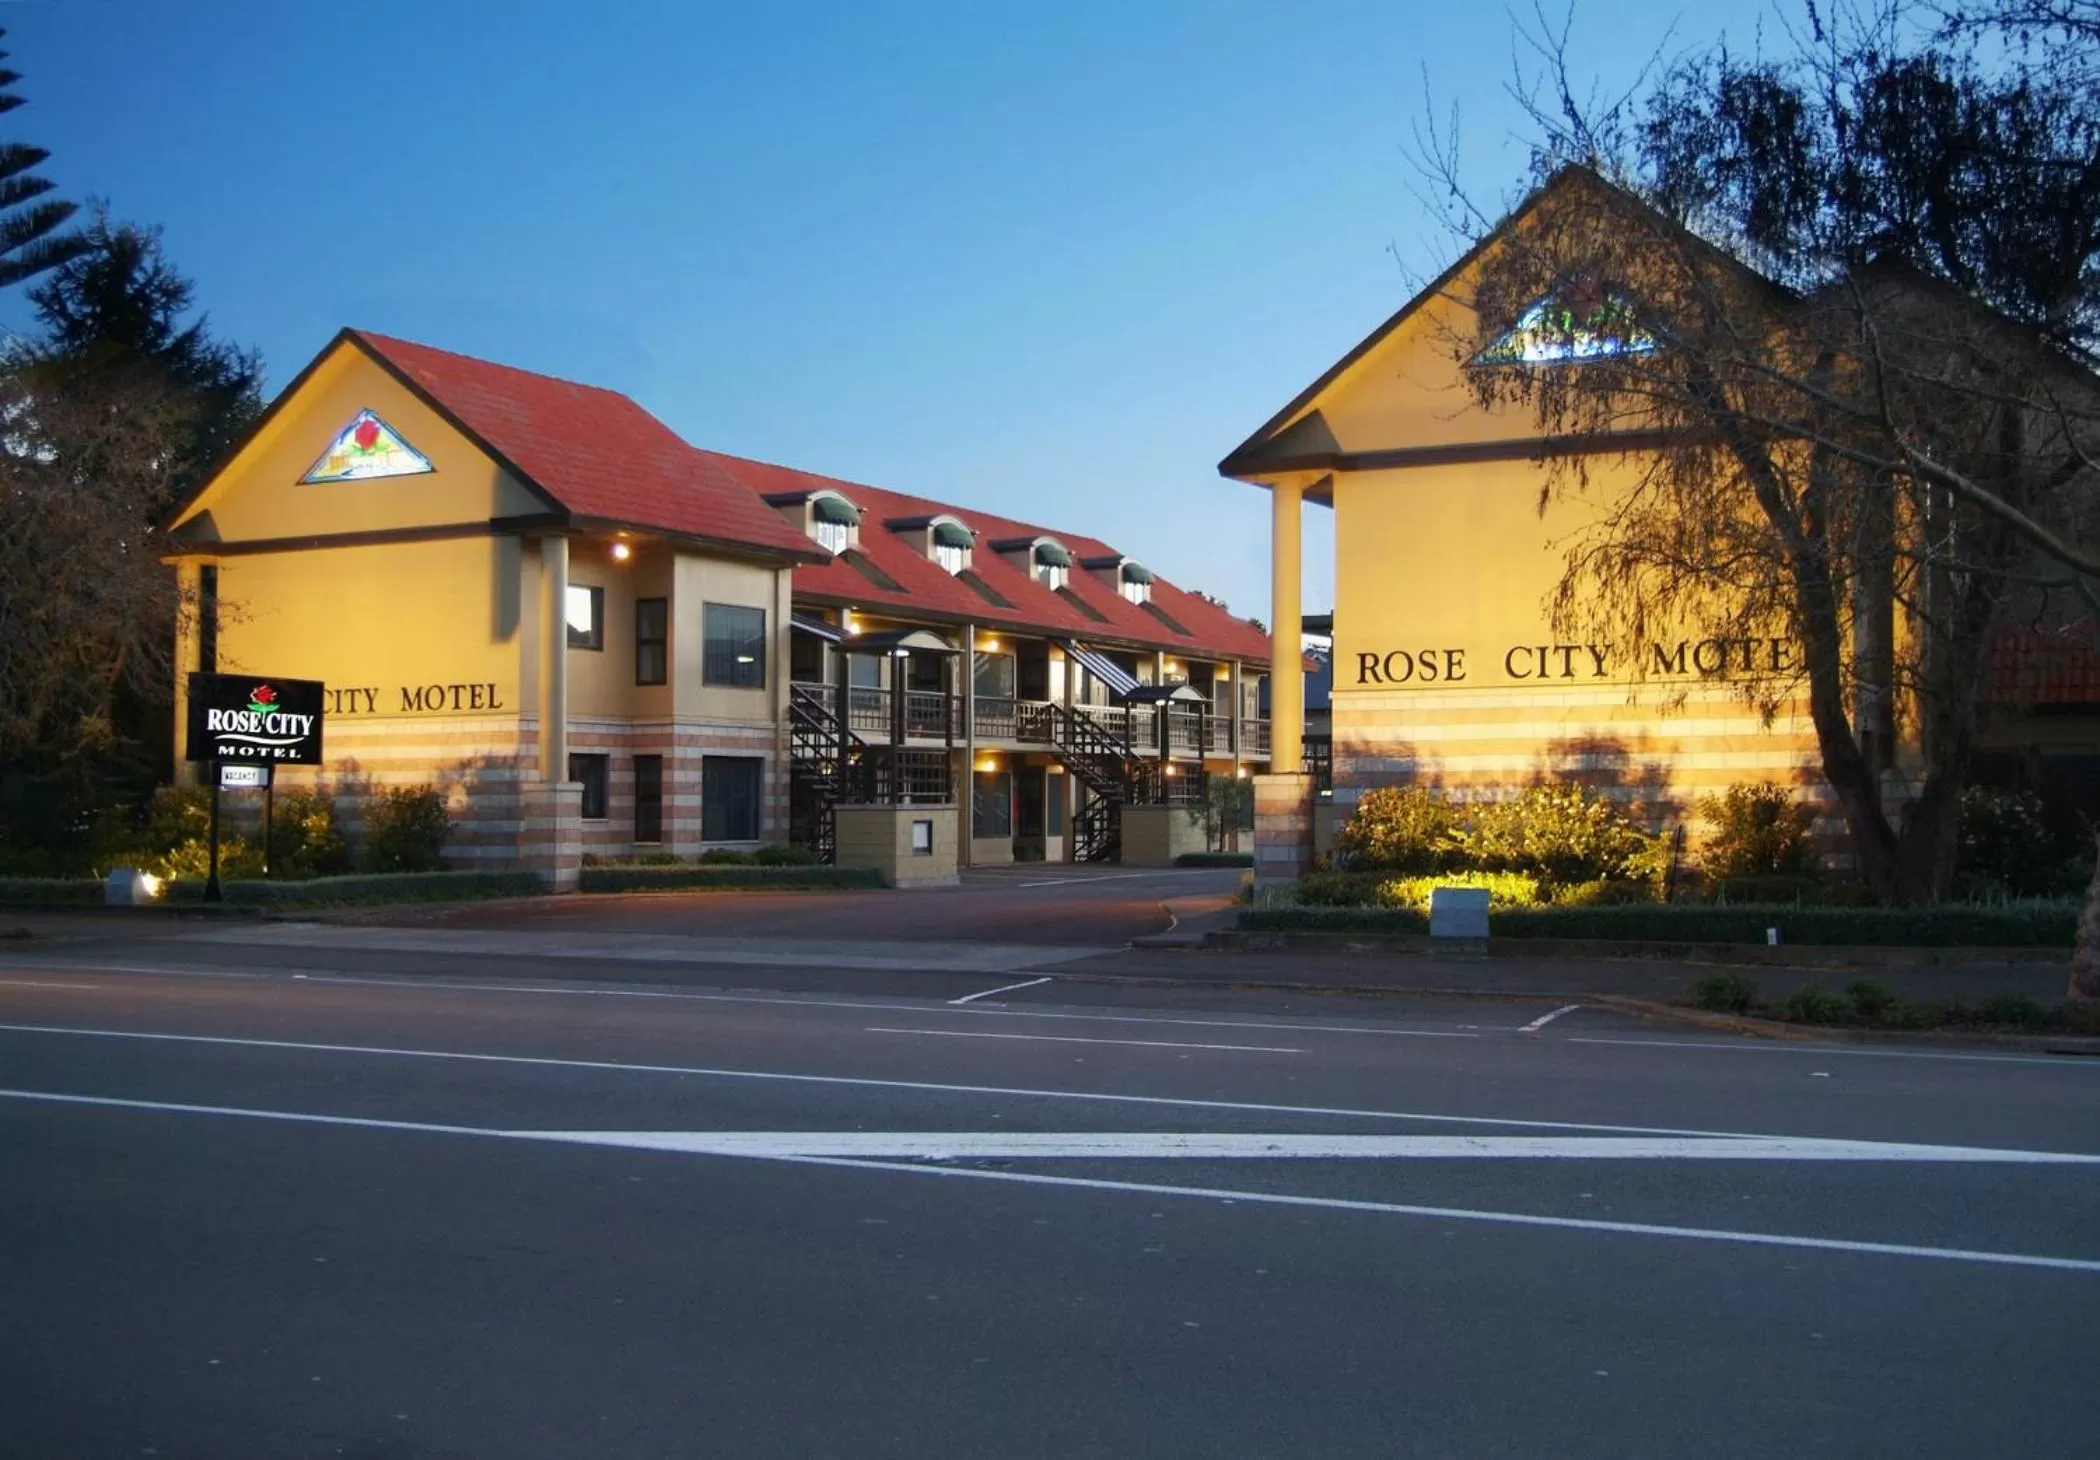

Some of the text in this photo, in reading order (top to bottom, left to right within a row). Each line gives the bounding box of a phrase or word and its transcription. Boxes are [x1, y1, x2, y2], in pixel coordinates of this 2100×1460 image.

[1356, 636, 1808, 684] ROSE CITY MOTE
[400, 683, 503, 712] MOTEL
[207, 708, 314, 736] ROSE CITY
[218, 745, 302, 759] MOTEL
